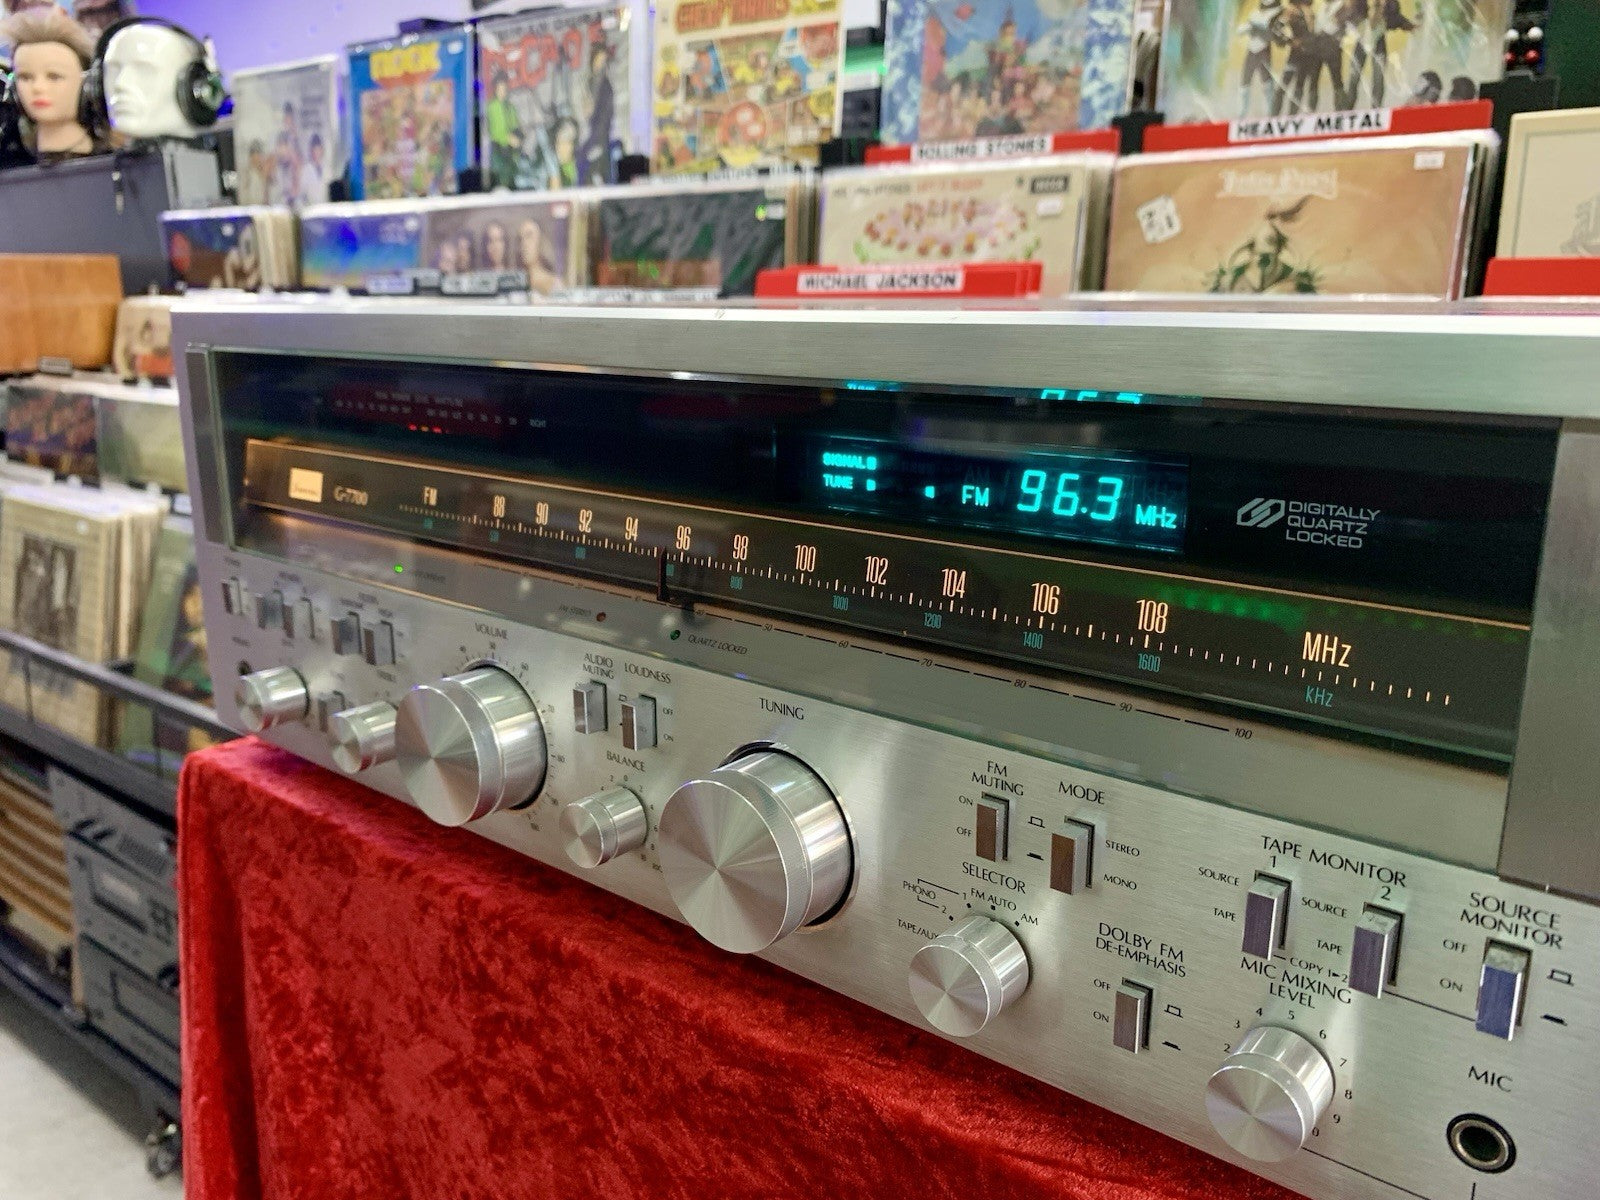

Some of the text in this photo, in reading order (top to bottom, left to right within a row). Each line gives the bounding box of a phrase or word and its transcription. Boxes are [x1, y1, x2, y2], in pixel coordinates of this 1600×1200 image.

[1237, 111, 1383, 138] HEAVY METAL
[918, 138, 1046, 159] ROLLING STONES
[804, 271, 957, 290] MICHAEL JACKSON
[822, 452, 866, 469] SIGNAL
[822, 473, 854, 490] TUNE
[961, 469, 1178, 530] FM 96.3 MHz
[1288, 500, 1381, 522] DIGITALLY
[1287, 515, 1368, 535] QUARTZ
[1285, 529, 1363, 549] LOCKED
[493, 494, 505, 518] 88
[536, 502, 549, 526] 90
[578, 509, 593, 533] 92
[625, 517, 639, 542] 94
[675, 525, 692, 551] 96
[732, 534, 749, 561] 98
[795, 544, 817, 573] 100
[864, 556, 889, 586] 102
[941, 568, 966, 599] 104
[1030, 582, 1061, 615] 106
[1136, 599, 1169, 634] 108
[1302, 631, 1352, 668] MHz
[475, 622, 508, 640] VOLUME
[688, 634, 749, 656] QUARTZ LOCKED
[584, 653, 614, 669] AUDIO
[1022, 631, 1043, 650] 1400
[1137, 653, 1161, 673] 1600
[1305, 685, 1334, 708] KHz
[582, 663, 615, 680] MUTING
[624, 662, 672, 685] LOUDNESS
[838, 639, 850, 649] 60
[921, 658, 933, 668] 70
[1013, 678, 1027, 690] 80
[1119, 702, 1133, 714] 90
[1234, 727, 1253, 740] 100
[758, 697, 805, 721] TUNING
[606, 750, 646, 773] BALANCE
[987, 760, 1008, 778] FM
[971, 772, 1024, 797] MUTING
[1058, 781, 1106, 805] MODE
[958, 794, 974, 807] ON
[956, 825, 973, 838] OFF
[1105, 839, 1141, 858] STEREO
[1260, 834, 1407, 889] TAPE MONITOR
[1269, 855, 1277, 868] 1
[962, 861, 1026, 895] SELECTOR
[1103, 872, 1138, 891] MONO
[1198, 865, 1241, 887] SOURCE
[902, 880, 937, 901] PHONO
[970, 887, 1017, 912] FM AUTO
[1380, 885, 1392, 901] 2
[1213, 906, 1237, 923] TAPE
[1301, 896, 1349, 919] SOURCE
[1469, 891, 1561, 931] SOURCE
[1020, 913, 1039, 926] AM
[1460, 909, 1564, 951] MONITOR
[1098, 921, 1185, 963] DOLBY FM
[1316, 939, 1344, 956] TAPE
[1442, 938, 1468, 954] OFF
[1095, 936, 1187, 978] DE-EMPHASIS
[1289, 957, 1324, 975] COPY
[1093, 977, 1112, 992] OFF
[1240, 956, 1352, 1004] MIC MIXING
[1438, 977, 1464, 994] ON
[1269, 982, 1316, 1009] LEVEL
[1092, 1010, 1110, 1024] ON
[1255, 1007, 1295, 1020] 4 5
[1233, 1019, 1241, 1030] 3
[1319, 1028, 1328, 1040] 6
[1223, 1043, 1231, 1053] 2
[1340, 1057, 1349, 1068] 7
[1468, 1064, 1514, 1093] MIC
[1344, 1089, 1353, 1100] 8
[1333, 1113, 1341, 1124] 9
